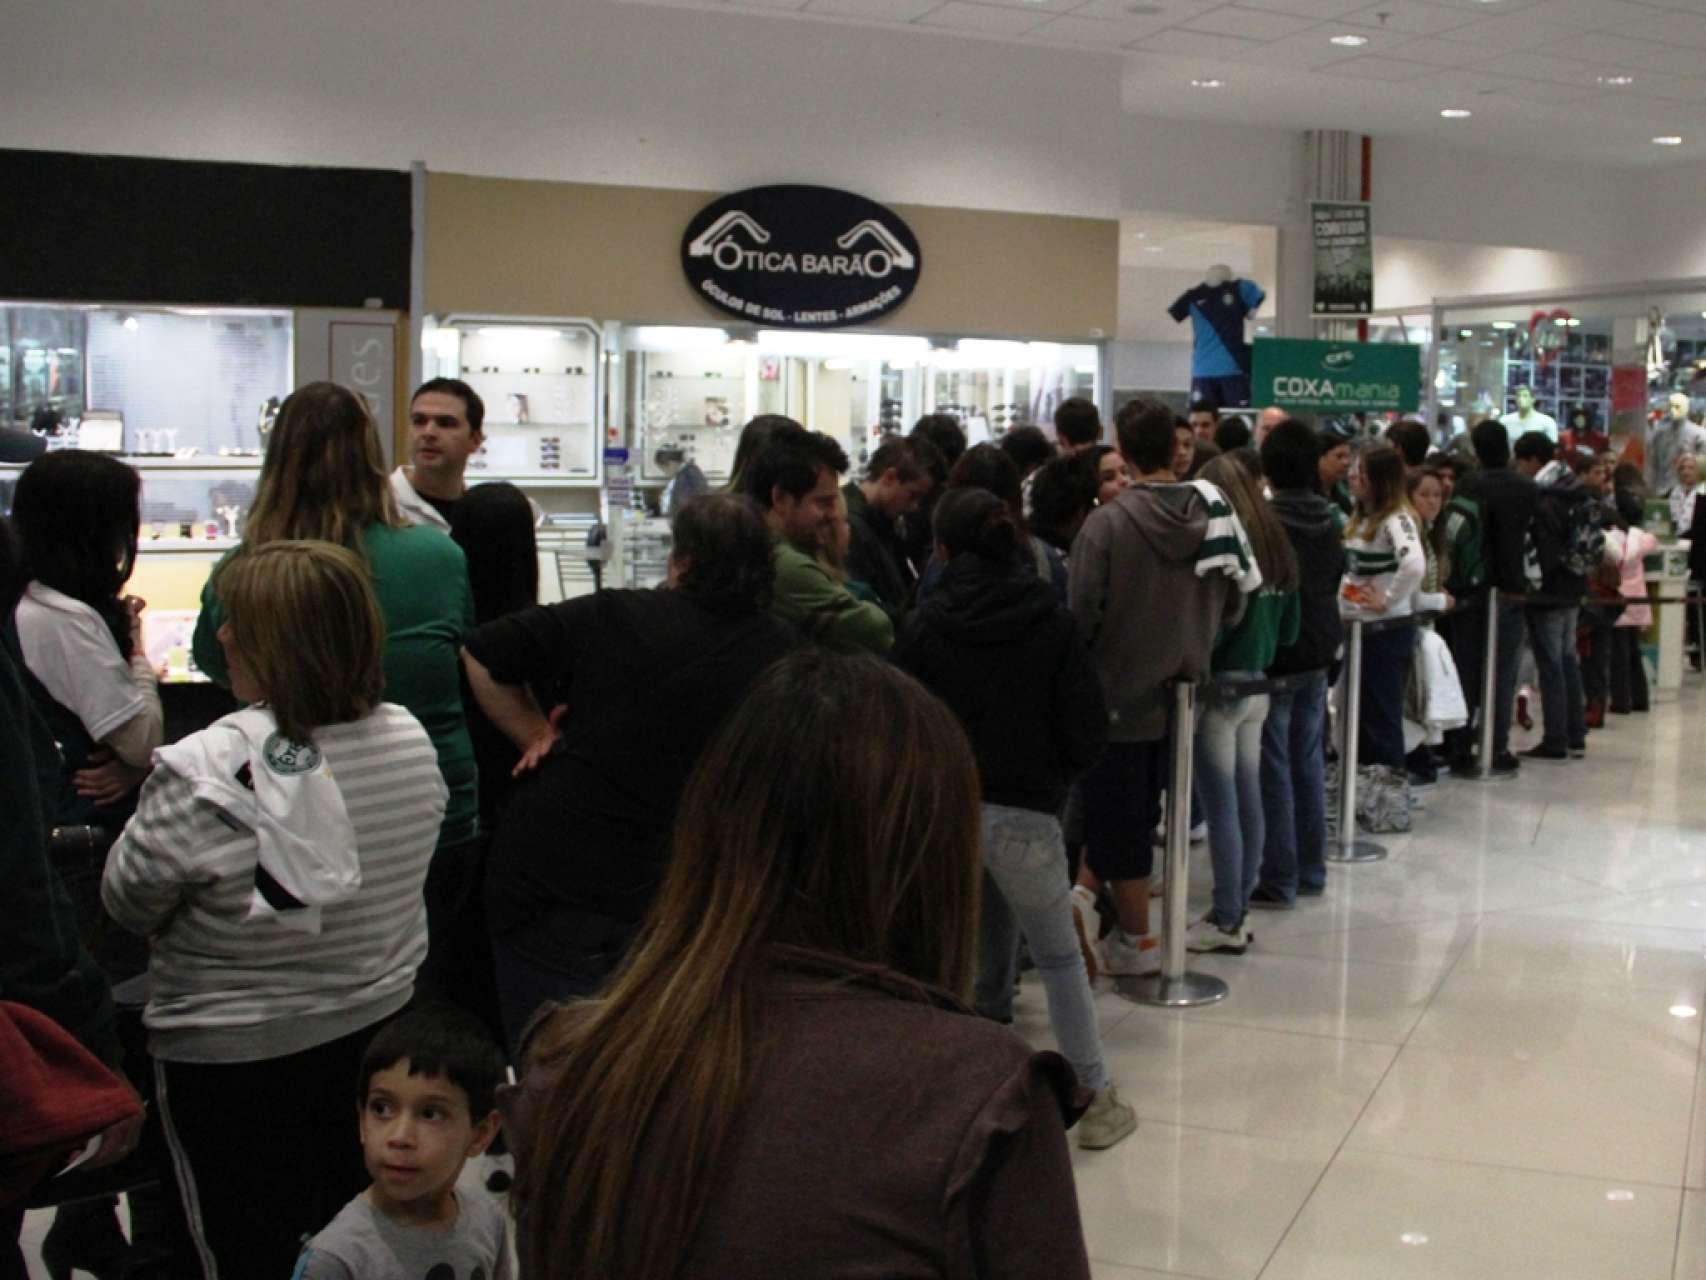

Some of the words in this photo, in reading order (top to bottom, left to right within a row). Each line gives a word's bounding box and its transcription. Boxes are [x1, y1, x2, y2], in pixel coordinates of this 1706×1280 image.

[713, 234, 798, 272] ÓTICA
[745, 302, 762, 316] DE
[763, 307, 785, 321] SOL
[793, 310, 838, 323] LENTES
